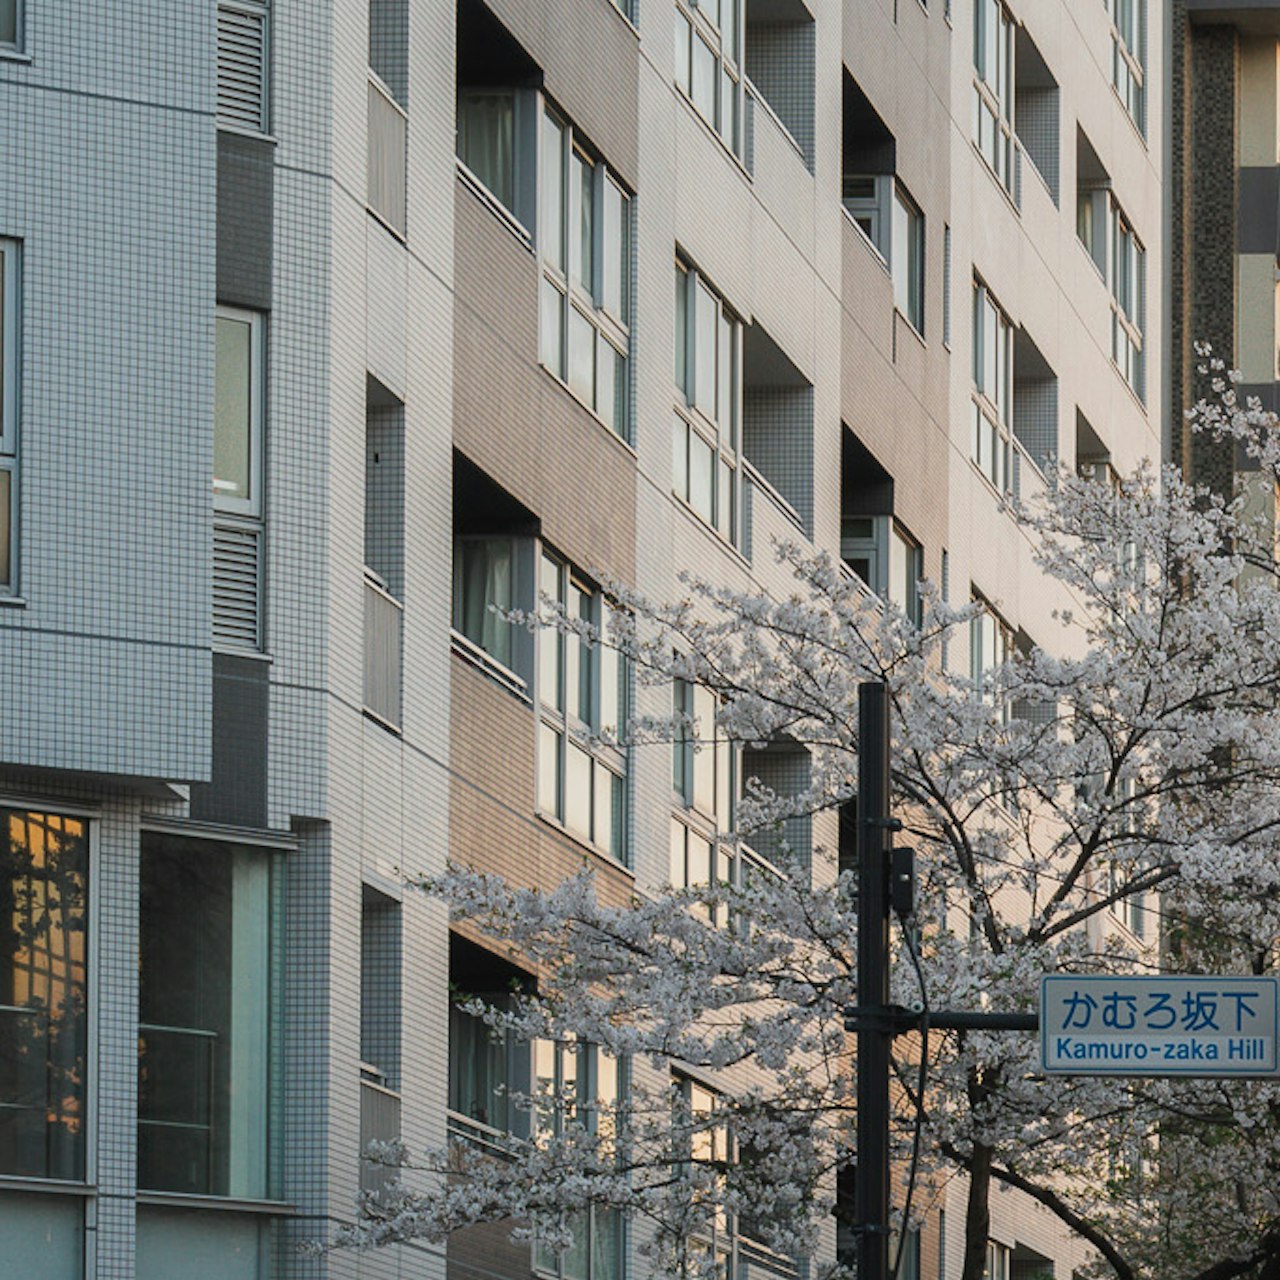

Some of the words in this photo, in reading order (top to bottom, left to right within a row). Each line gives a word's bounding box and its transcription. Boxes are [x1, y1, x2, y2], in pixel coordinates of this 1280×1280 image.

[1061, 990, 1260, 1032] かむろ坂下
[1056, 1037, 1219, 1060] Kamuro-zaka
[1227, 1038, 1265, 1060] Hill
